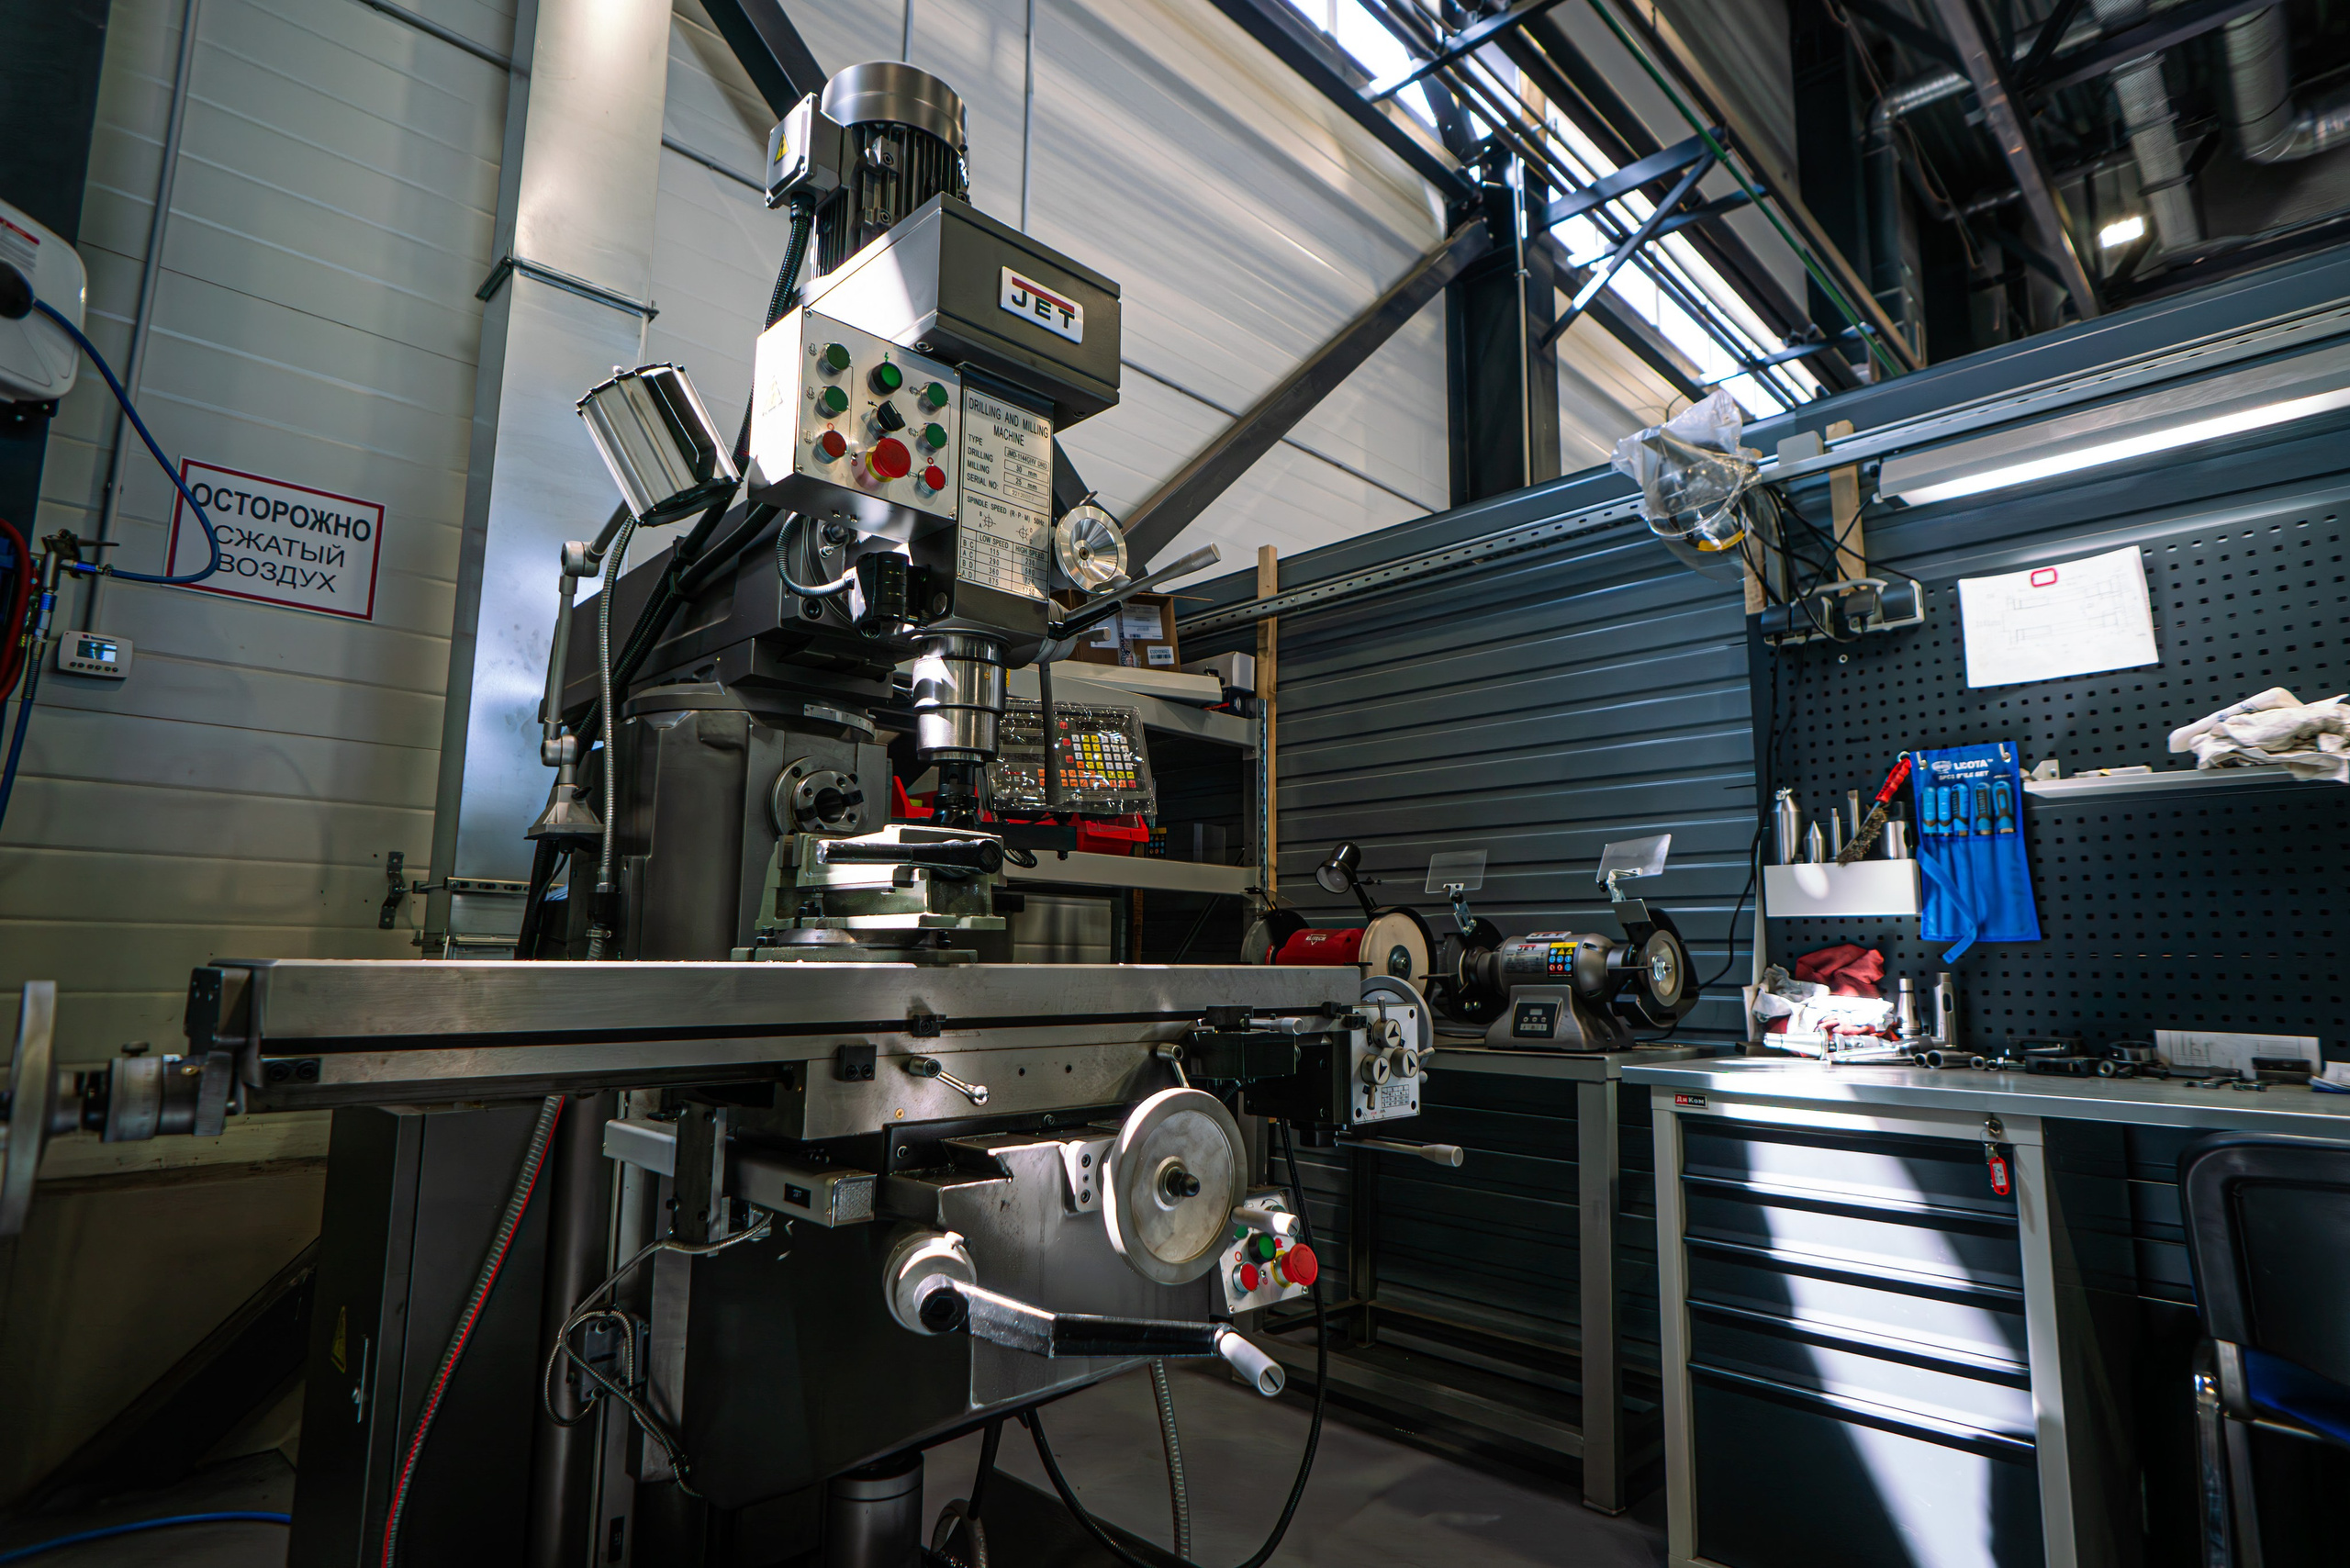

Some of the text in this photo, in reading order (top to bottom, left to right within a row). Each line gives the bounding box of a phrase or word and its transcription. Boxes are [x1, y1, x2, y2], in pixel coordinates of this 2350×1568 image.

[1011, 289, 1075, 329] JET
[968, 397, 1048, 439] DRILLING AND MILLING
[968, 433, 983, 446] TYPE
[993, 424, 1024, 447] MACHINE
[968, 446, 993, 463] DRILLING
[1016, 465, 1023, 474] 30
[966, 473, 987, 487] SERIAL
[967, 459, 990, 475] MILLING
[1015, 477, 1022, 486] 25
[191, 482, 372, 542] ОСТОРОЖНО
[967, 496, 988, 509] SPINDLE
[990, 503, 1007, 514] SPEED
[213, 524, 345, 568] СЖАТЫЙ
[979, 533, 1009, 549] LOW SPEED
[990, 547, 1000, 556] 115
[1015, 545, 1045, 559] HIGH SPEED
[989, 557, 1000, 566] 290
[1024, 557, 1035, 567] 230
[217, 553, 337, 593] ВОЗДУХ
[989, 567, 1000, 577] 360
[1024, 567, 1035, 577] 580
[988, 577, 999, 586] 875
[1953, 759, 1988, 770] LICOTA
